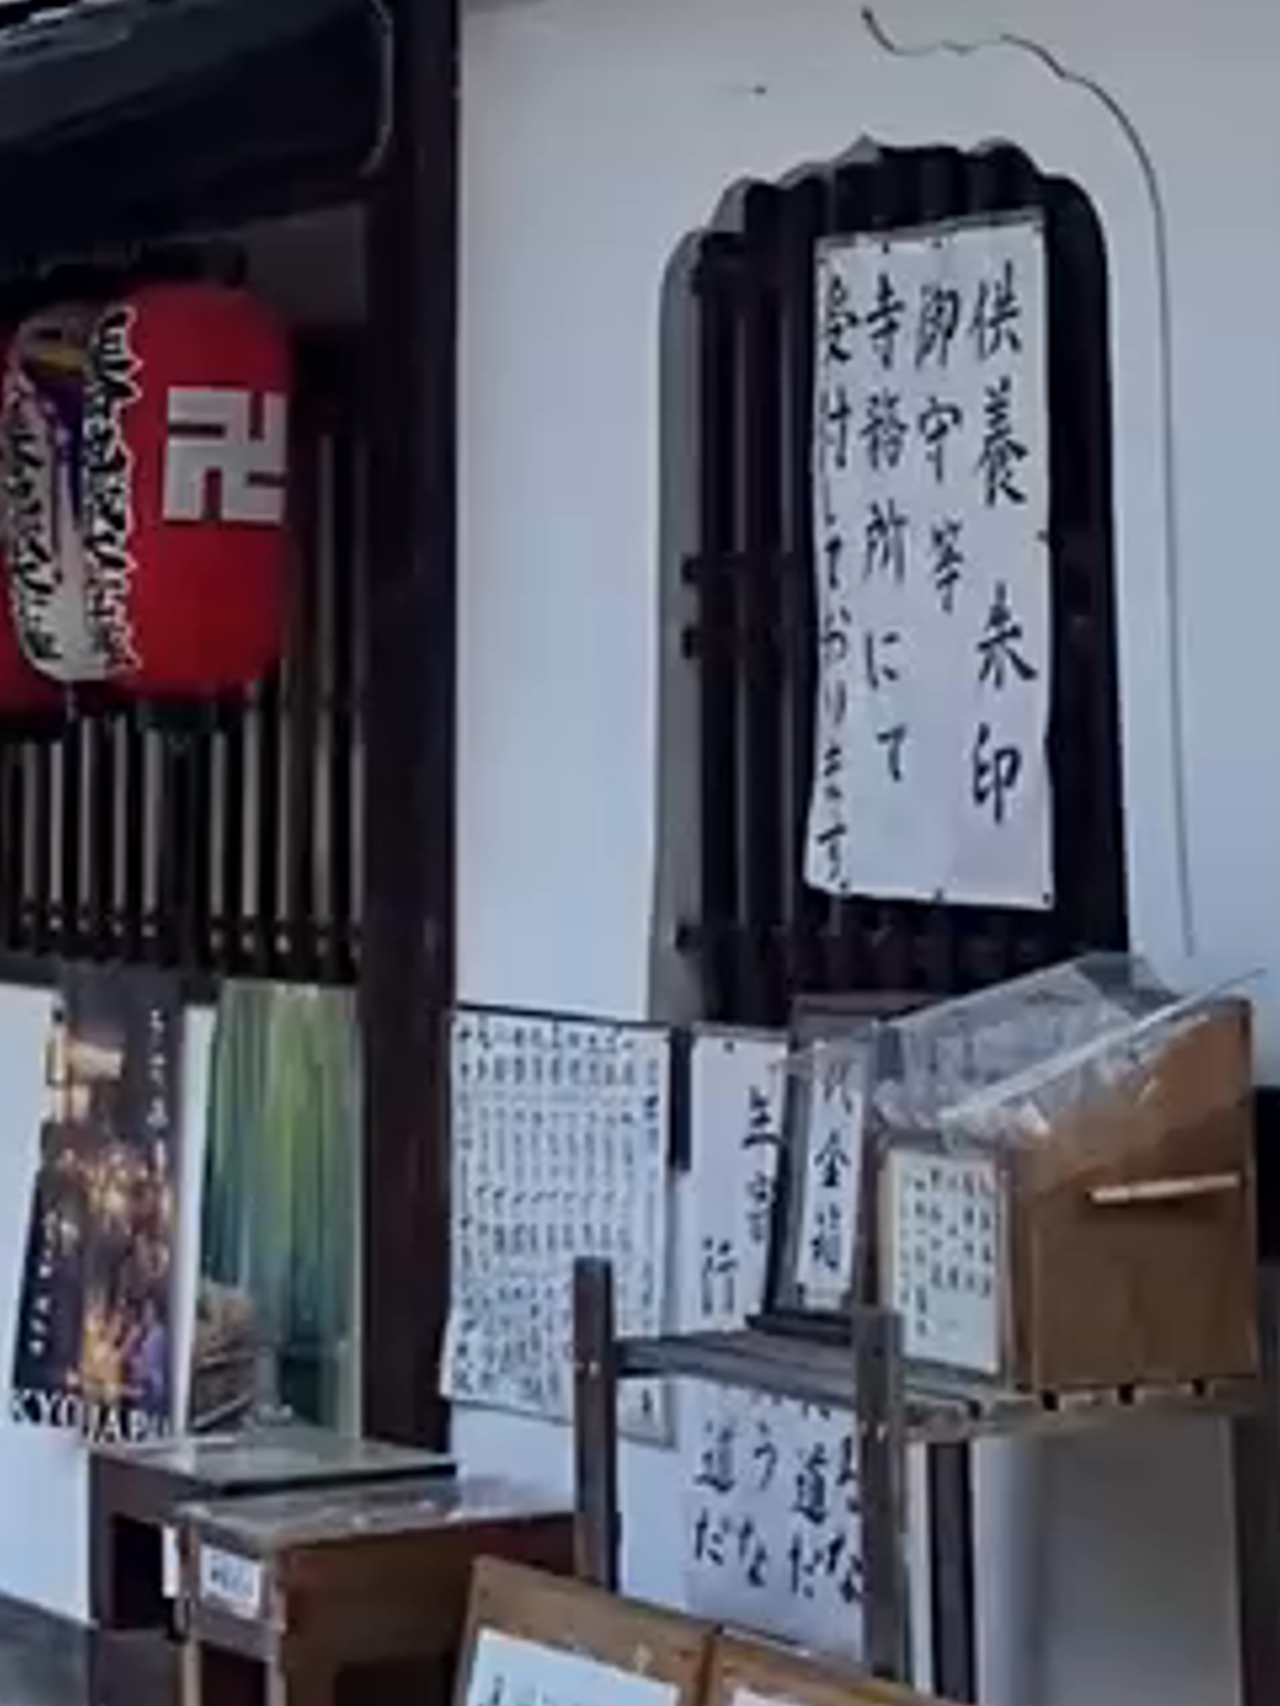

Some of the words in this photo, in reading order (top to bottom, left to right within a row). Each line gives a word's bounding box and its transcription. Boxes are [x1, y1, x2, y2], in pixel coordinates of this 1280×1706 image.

[858, 272, 910, 782] 寺務所にて
[968, 259, 1036, 824] 供養朱印
